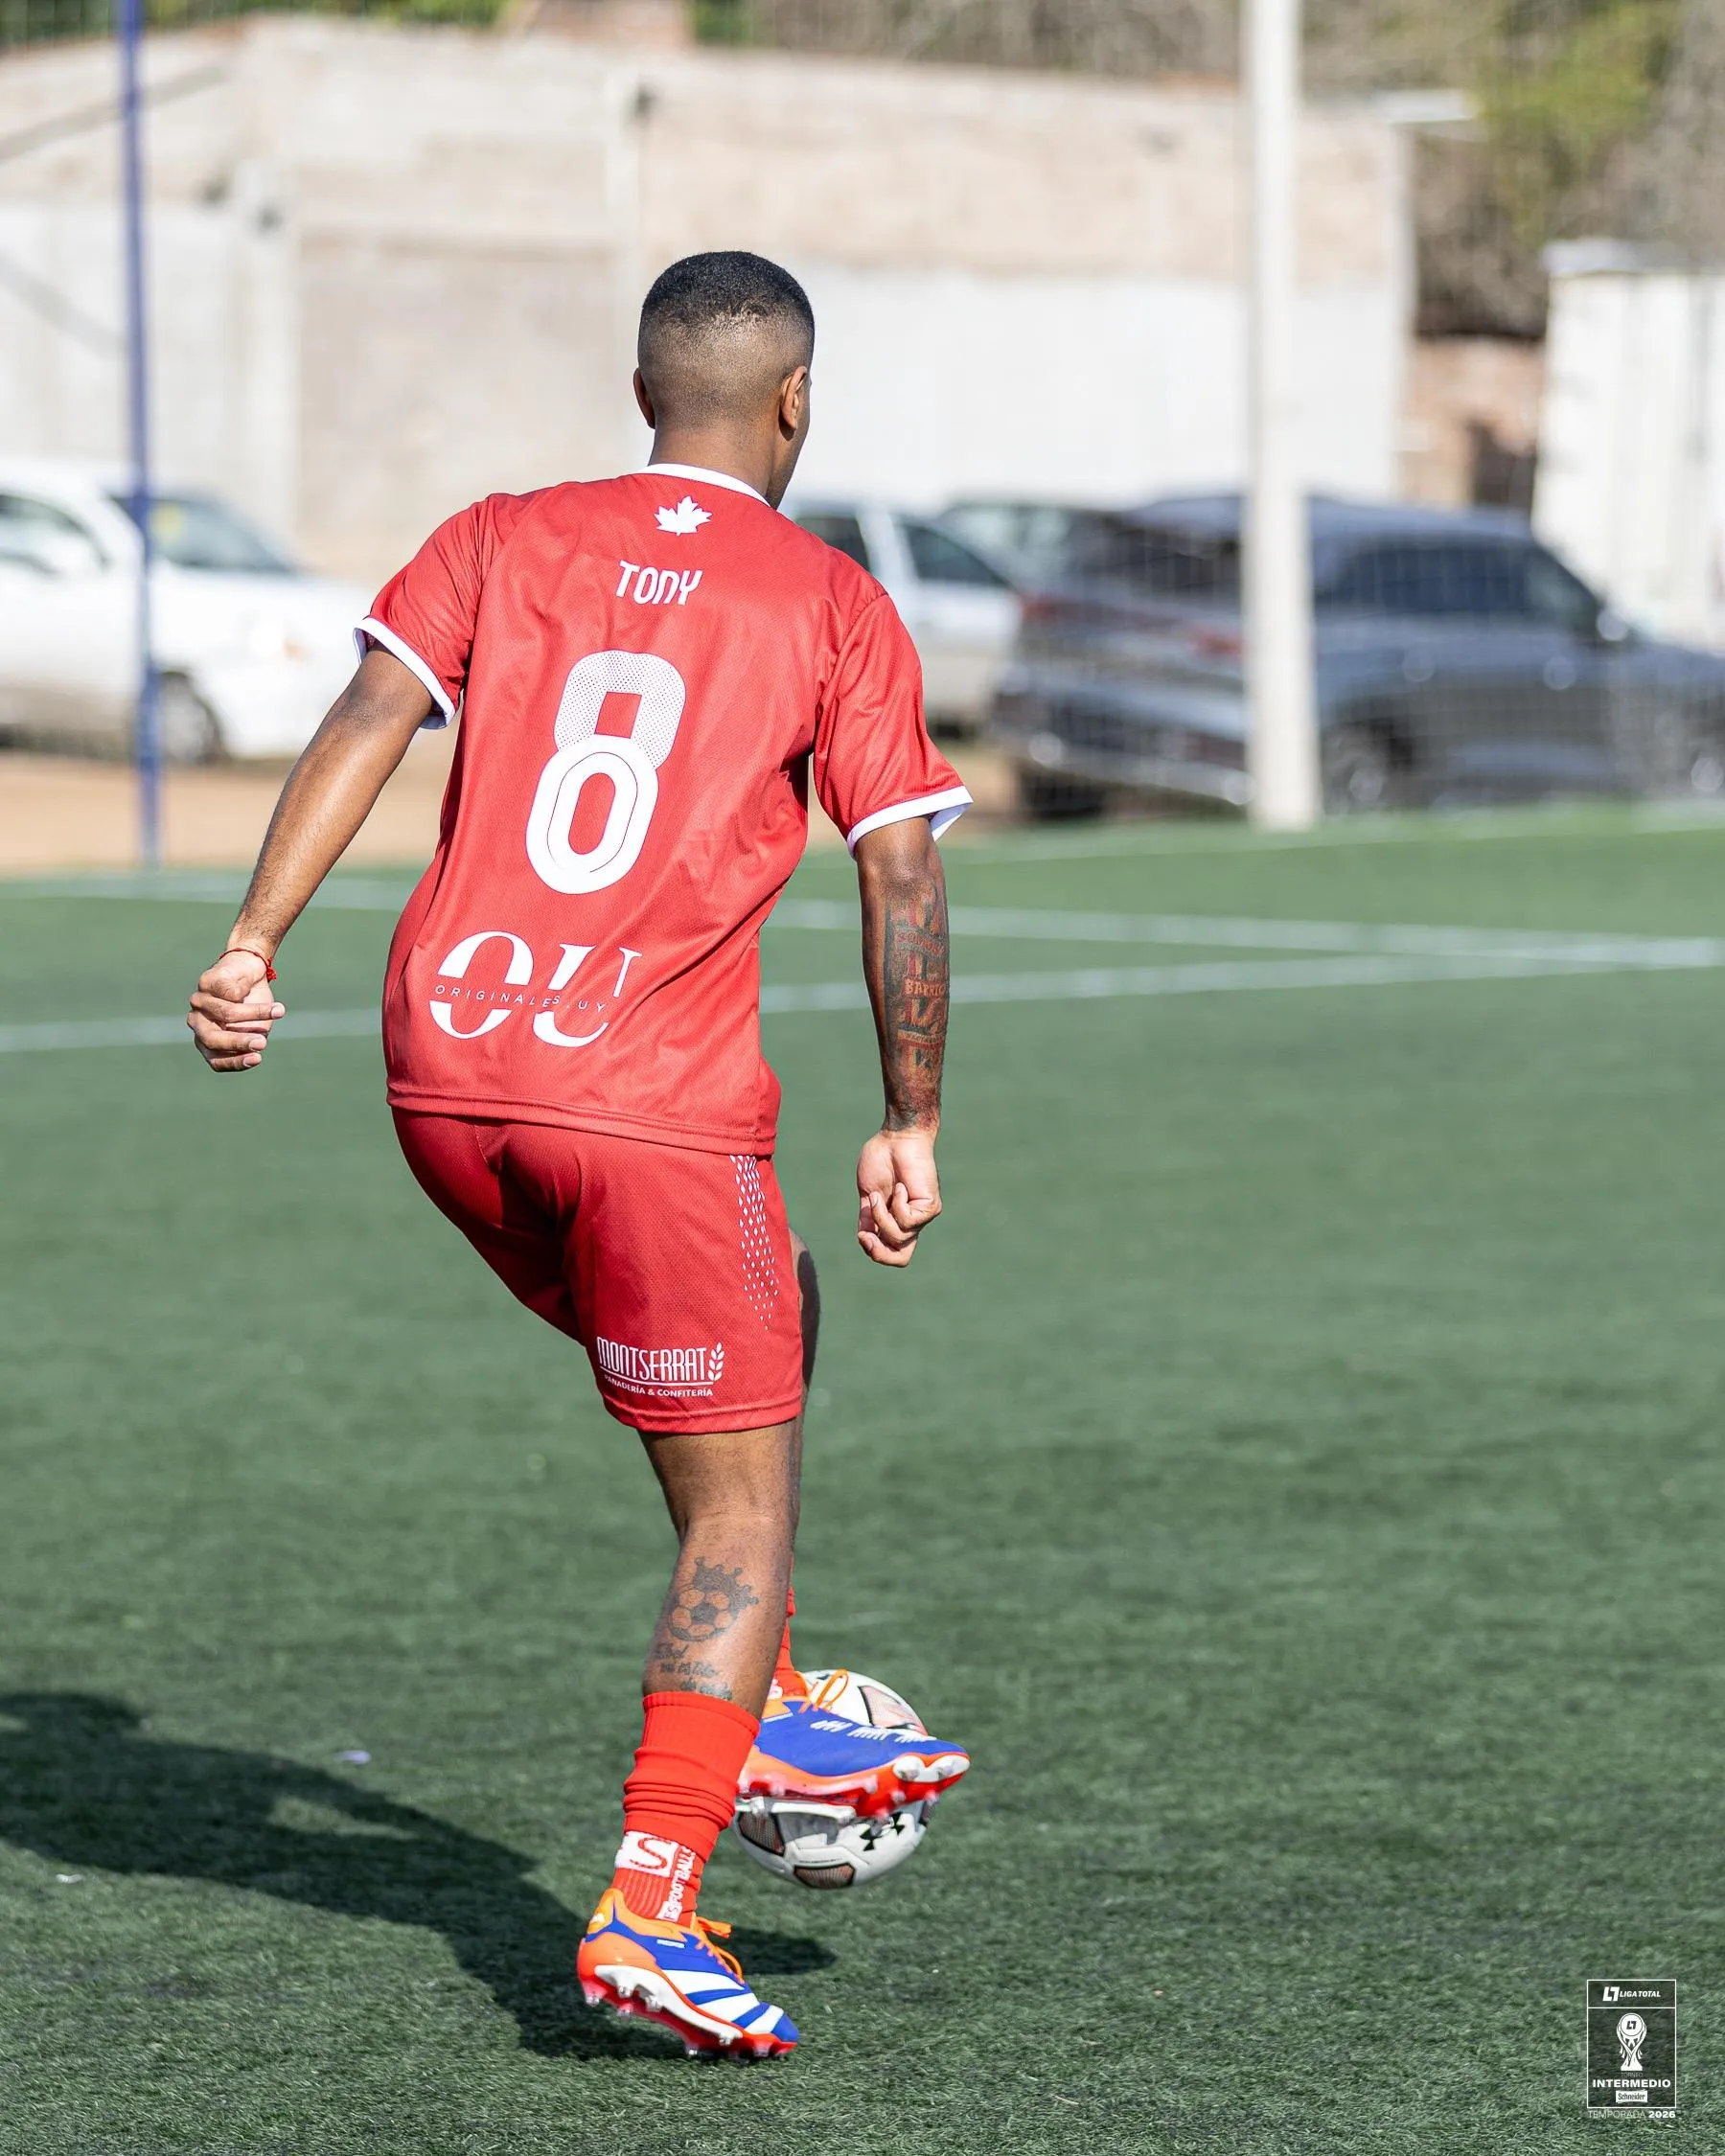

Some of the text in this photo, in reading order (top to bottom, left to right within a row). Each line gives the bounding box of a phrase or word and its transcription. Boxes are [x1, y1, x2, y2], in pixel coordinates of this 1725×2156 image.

[615, 560, 702, 606] TONY
[525, 649, 686, 895] 8
[597, 1336, 706, 1382] MONTSERRAT
[605, 1374, 714, 1397] PANADERÍA & CONFITERÍA
